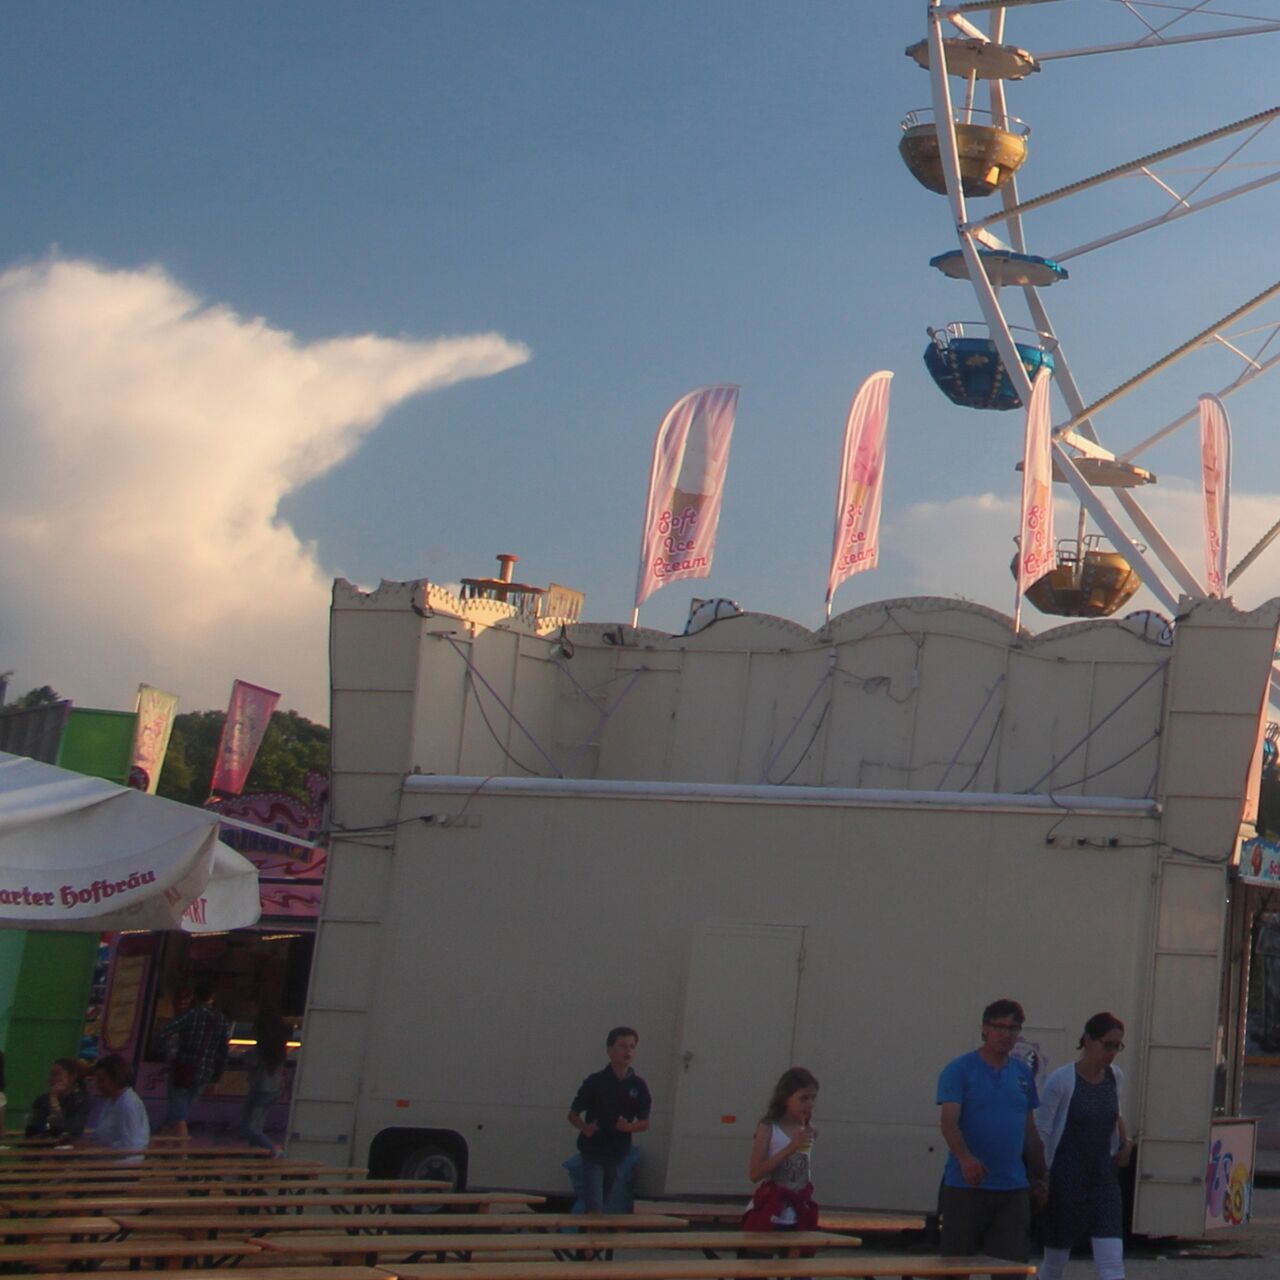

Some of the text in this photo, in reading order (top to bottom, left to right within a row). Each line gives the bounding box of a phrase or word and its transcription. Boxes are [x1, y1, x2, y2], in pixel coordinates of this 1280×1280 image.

[658, 506, 697, 535] Soft
[663, 536, 696, 555] Ice
[653, 556, 708, 578] Cream
[60, 870, 156, 909] Hofbräu
